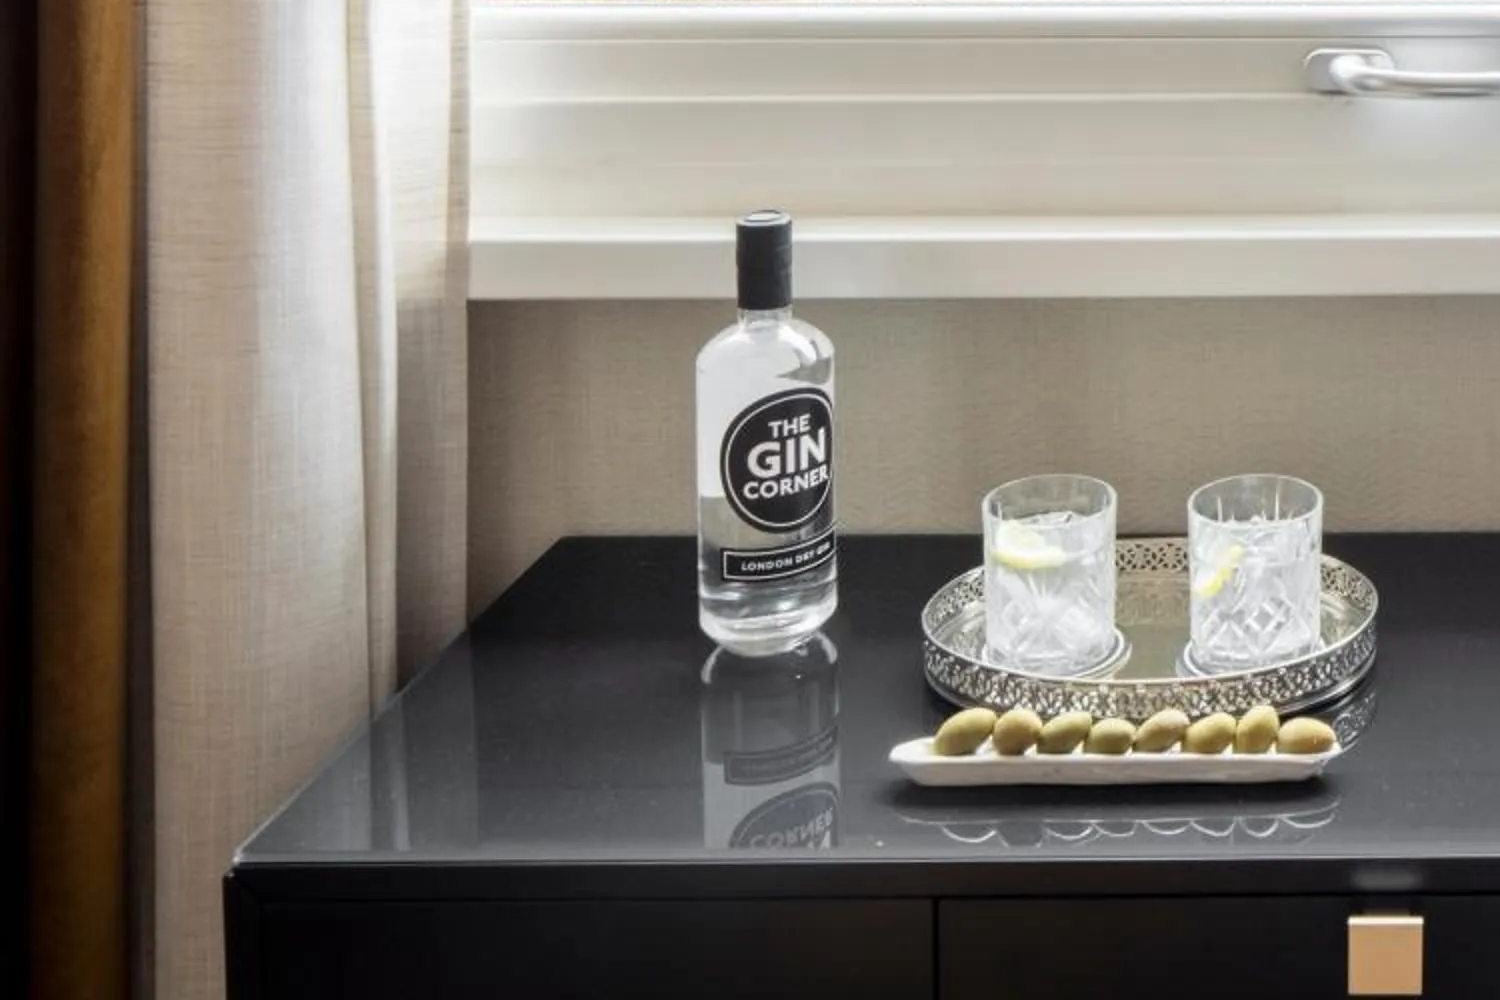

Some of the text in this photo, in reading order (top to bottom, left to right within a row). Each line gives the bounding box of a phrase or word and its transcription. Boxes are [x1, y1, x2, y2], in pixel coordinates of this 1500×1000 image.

[767, 413, 811, 439] THE
[747, 426, 826, 479] GIN
[743, 464, 829, 500] CORNER
[741, 557, 793, 572] LONDON
